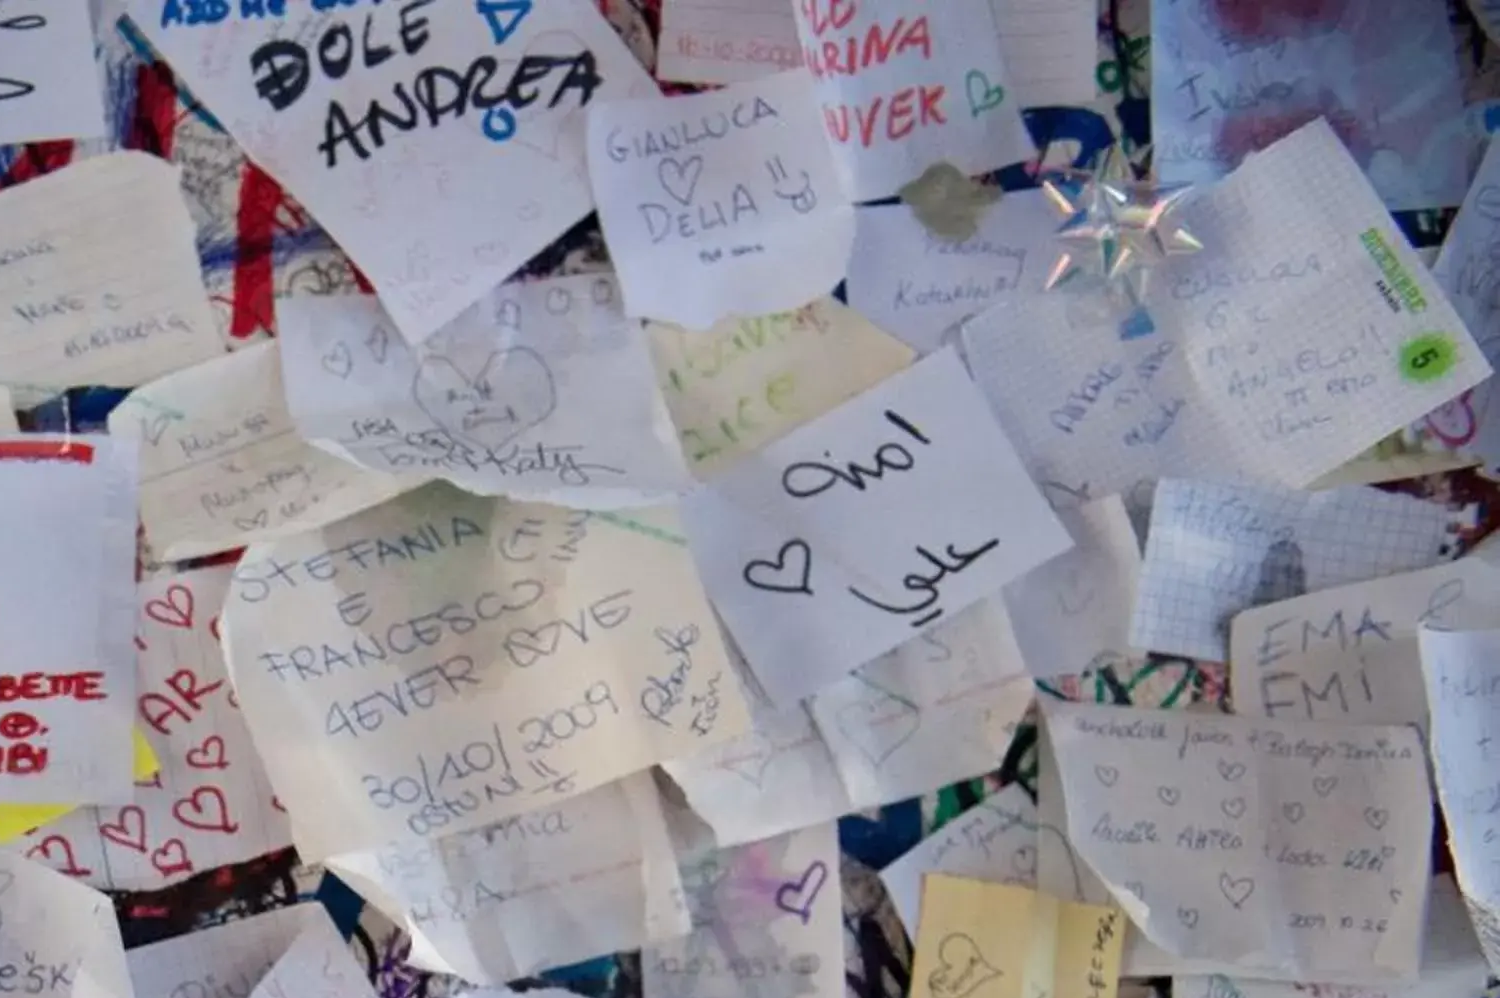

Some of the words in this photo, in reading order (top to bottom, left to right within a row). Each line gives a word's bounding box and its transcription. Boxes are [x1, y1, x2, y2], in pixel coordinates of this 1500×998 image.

[318, 49, 604, 167] ANDREA
[606, 97, 778, 162] GIANLUCA
[639, 185, 760, 243] DELIA
